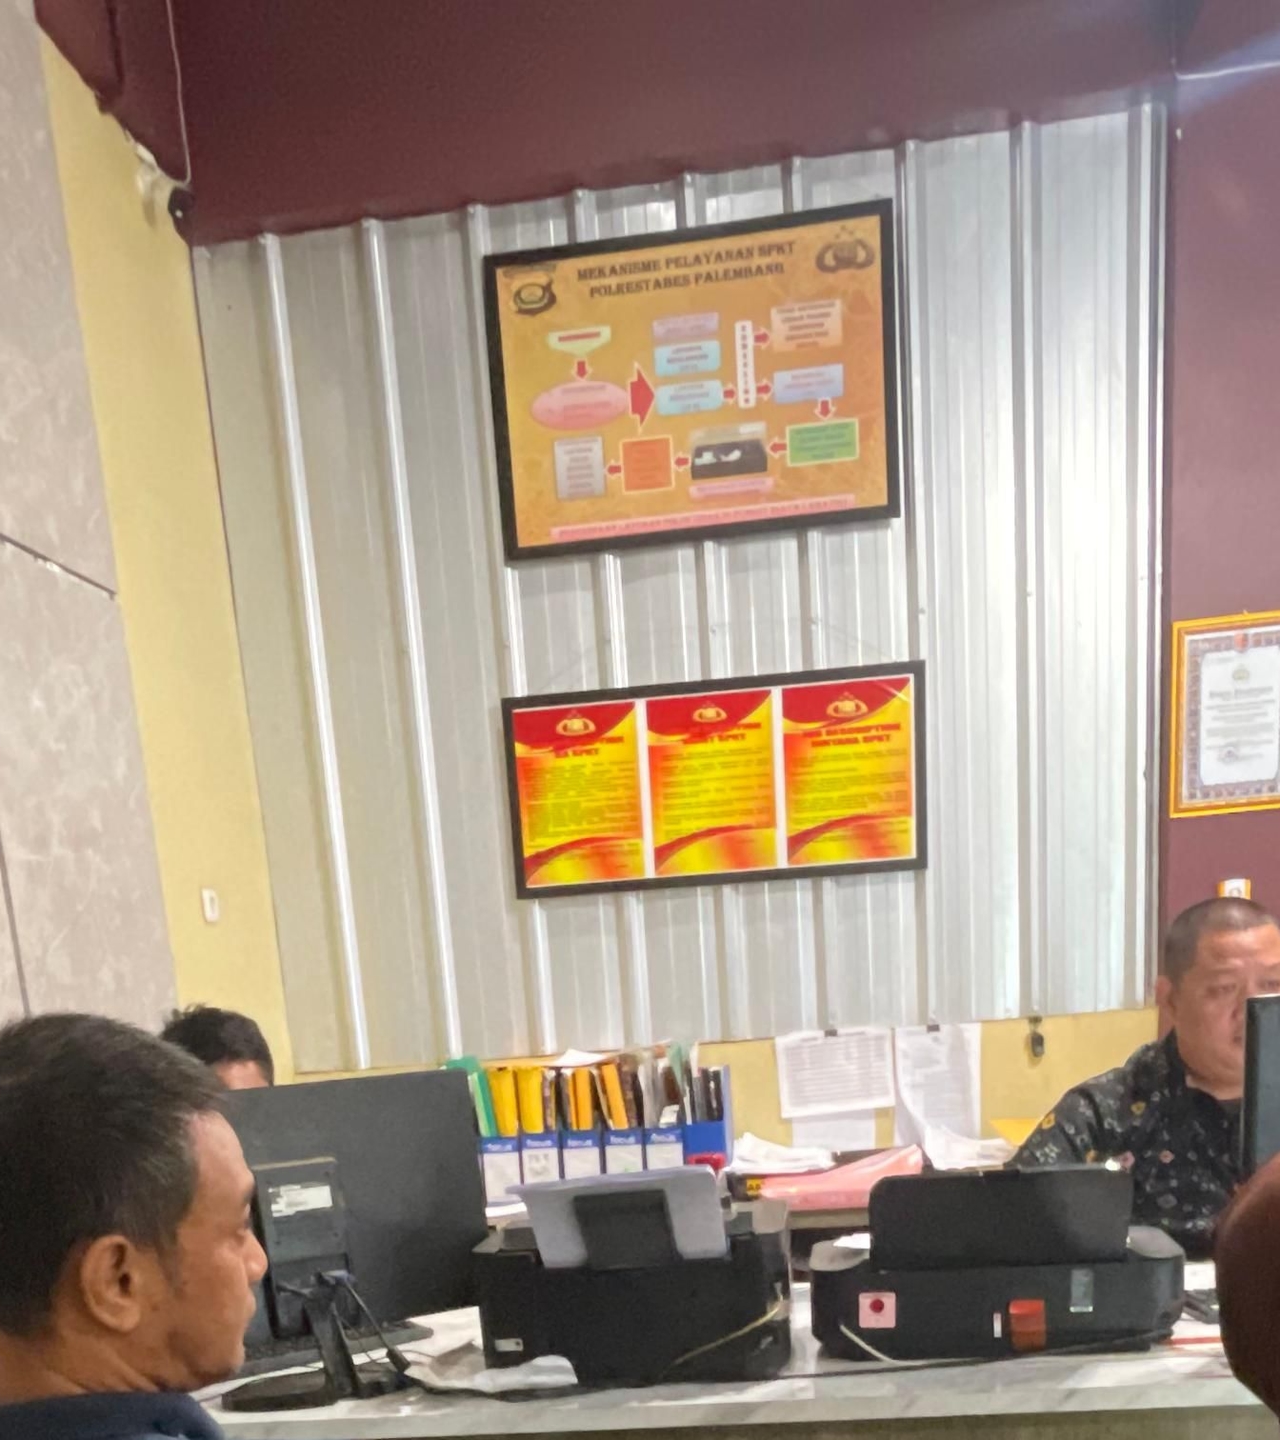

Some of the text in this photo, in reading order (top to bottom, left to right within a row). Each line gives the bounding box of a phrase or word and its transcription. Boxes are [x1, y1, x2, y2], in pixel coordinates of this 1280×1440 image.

[577, 259, 662, 282] MEKANISME
[589, 263, 784, 298] POLRESTABES PALEMBANG
